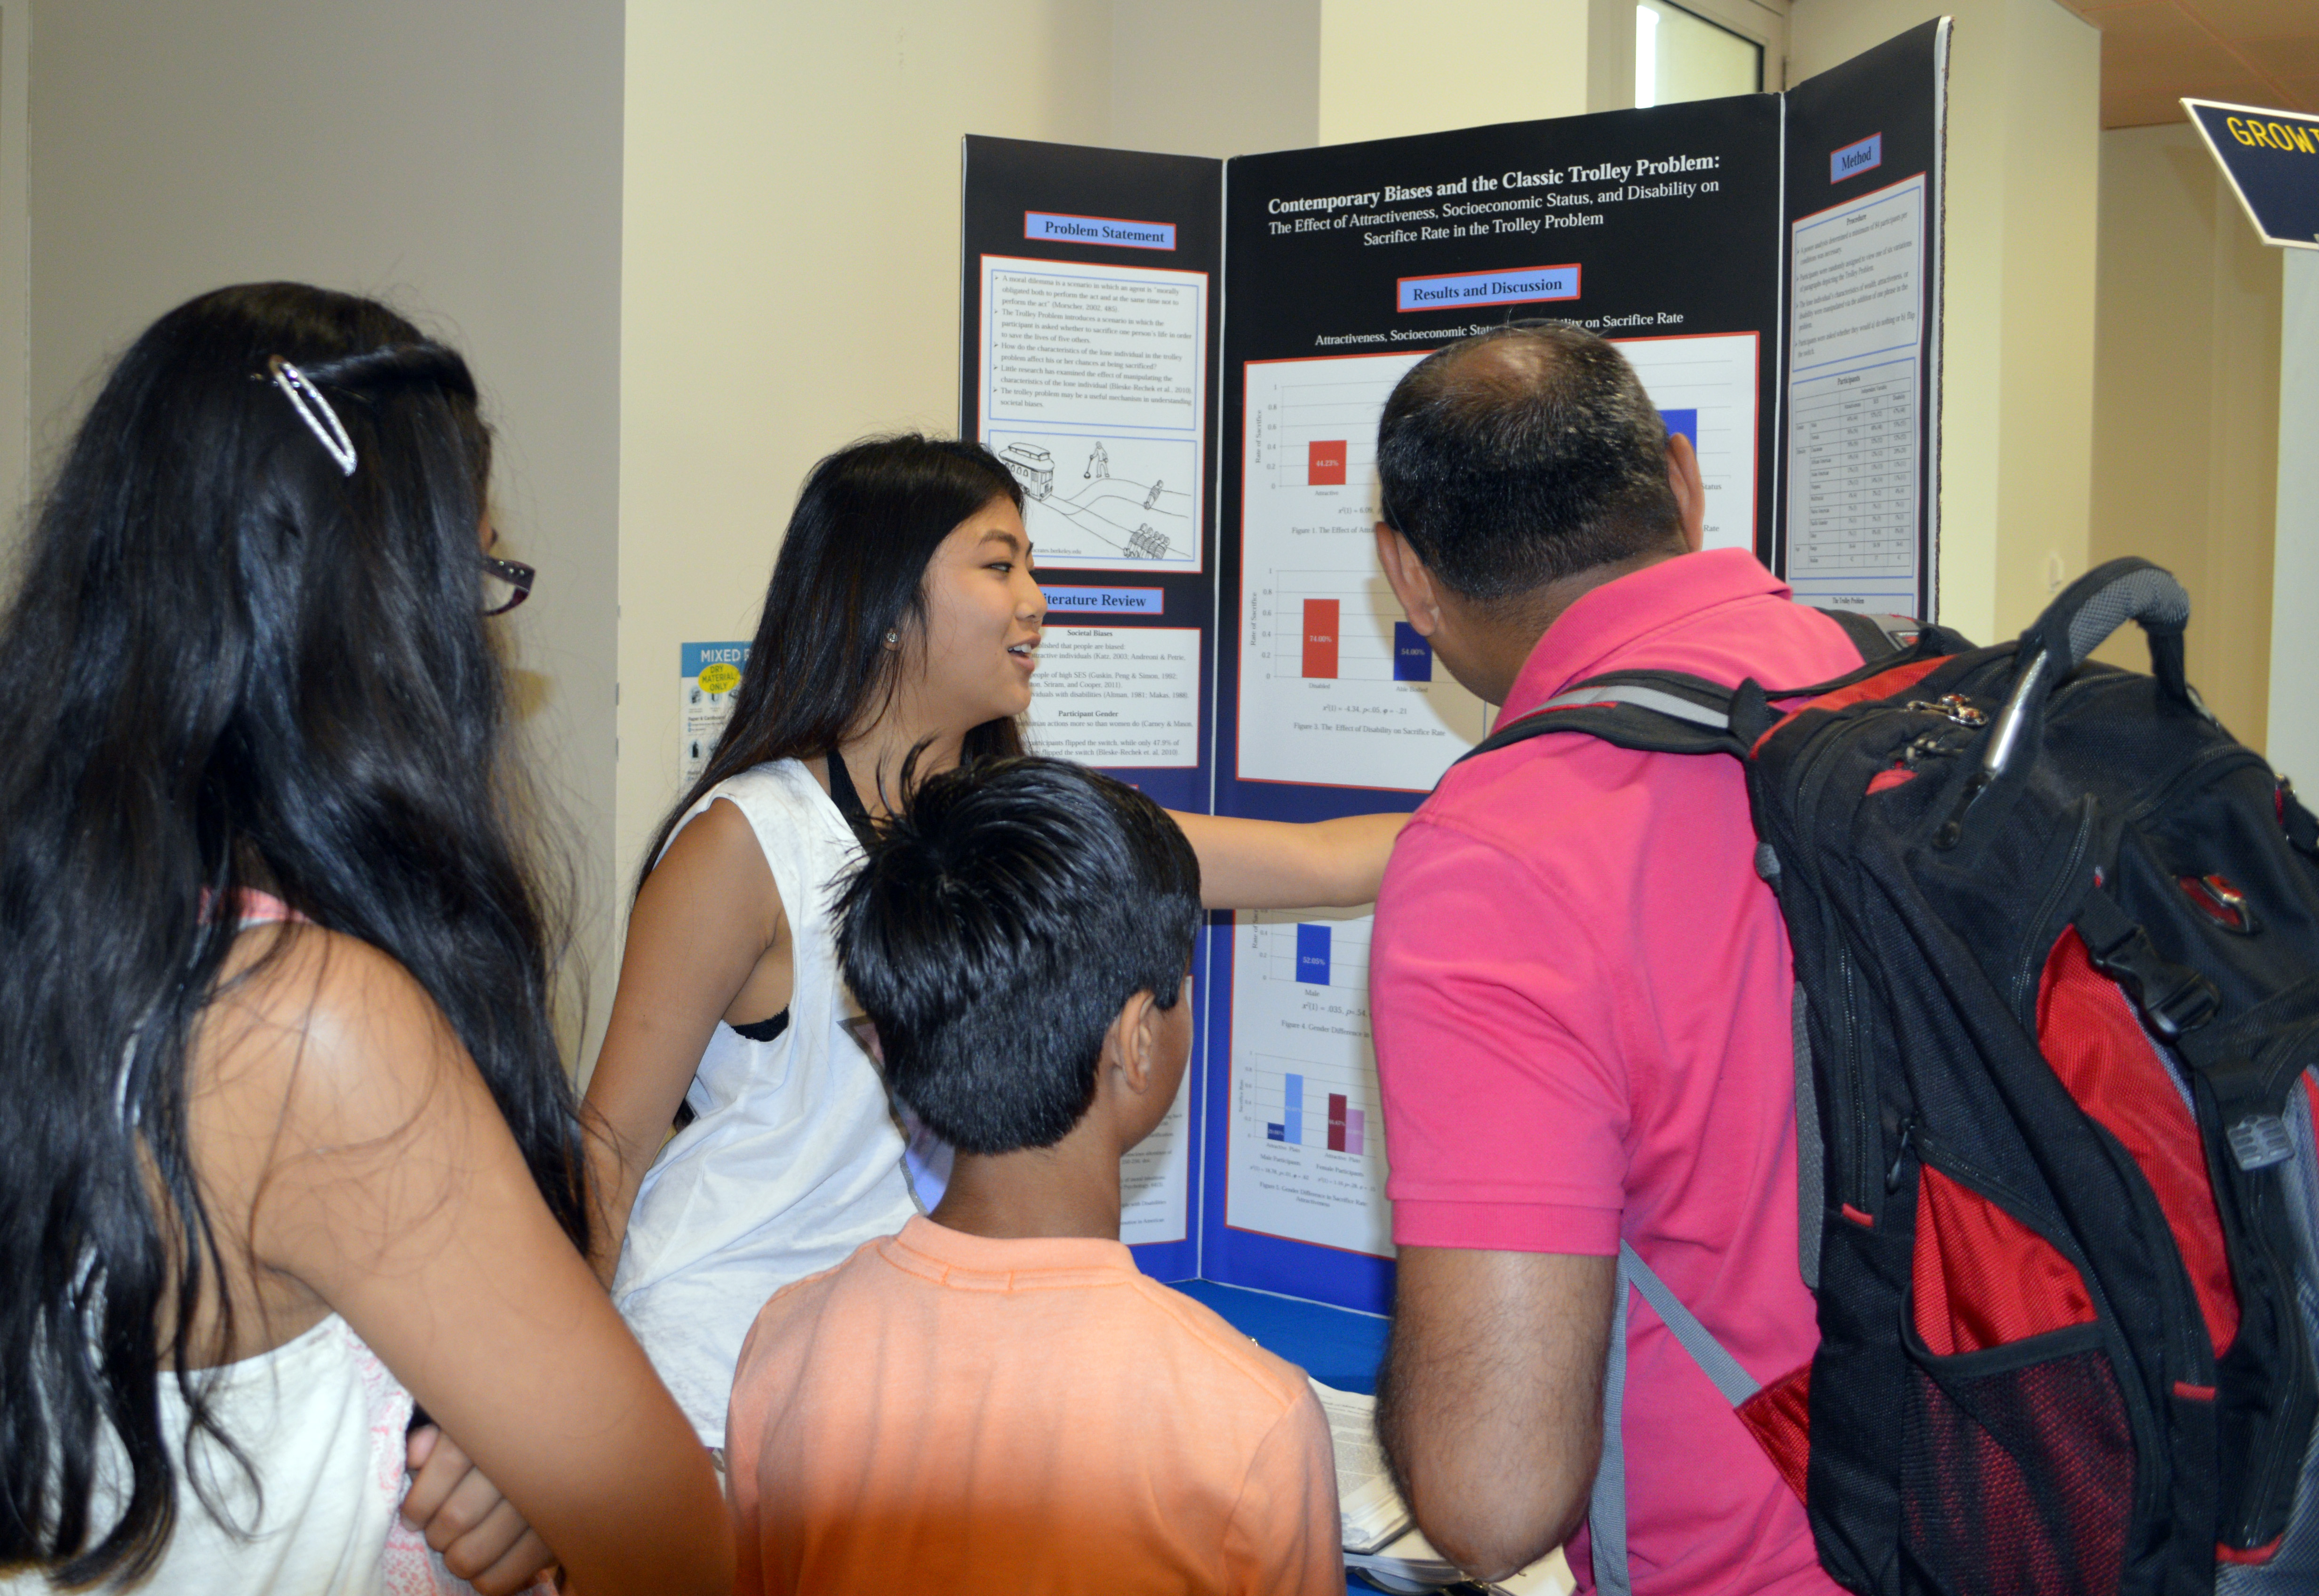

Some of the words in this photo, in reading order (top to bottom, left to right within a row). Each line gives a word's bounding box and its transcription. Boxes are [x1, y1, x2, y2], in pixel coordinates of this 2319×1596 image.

[1842, 146, 1871, 170] Method
[1268, 192, 1380, 214] Contemporary
[1384, 186, 1433, 202] Biases
[1436, 178, 1467, 196] and
[1471, 176, 1498, 192] the
[1502, 169, 1564, 188] Classic
[1568, 164, 1631, 182] Trolley
[1636, 156, 1719, 176] Problem:
[1269, 222, 1292, 234] The
[1295, 218, 1330, 232] Effect
[1334, 215, 1348, 228] of
[1349, 209, 1439, 226] Attractiveness,
[1442, 196, 1543, 217] Socioeconomic
[1546, 194, 1593, 207] Status,
[1598, 188, 1623, 203] and
[1627, 183, 1697, 200] Disability
[1701, 181, 1719, 192] on
[1847, 214, 1866, 225] Procedure
[1045, 221, 1098, 237] Problem
[1102, 226, 1164, 242] Statement
[1364, 230, 1417, 246] Sacrifice
[1421, 227, 1450, 240] Rate
[1453, 224, 1466, 237] in
[1469, 223, 1489, 235] the
[1492, 218, 1541, 233] Trolley
[1544, 214, 1604, 228] Problem
[1414, 287, 1459, 300] Results
[1463, 283, 1487, 296] and
[1492, 279, 1562, 294] Discussion
[1015, 310, 1036, 319] Trolley
[1585, 319, 1600, 328] on
[1603, 315, 1654, 327] Sacrifice
[1657, 313, 1684, 324] Rate
[1315, 334, 1387, 345] Attractiveness,
[1390, 327, 1467, 341] Socioeconomic
[1037, 345, 1080, 354] characteristics
[1107, 361, 1124, 369] being
[1045, 593, 1097, 605] iterature
[1102, 594, 1146, 606] Review
[701, 649, 740, 662] MIXED
[711, 665, 723, 673] DRY
[702, 672, 735, 683] MATERIAL
[710, 682, 727, 691] ONLY
[1294, 722, 1312, 731] Figure
[1363, 726, 1392, 735] Disability
[1303, 957, 1325, 965] 52.05%
[1281, 1020, 1300, 1029] Figure
[1308, 1024, 1330, 1032] Gender
[1331, 1027, 1362, 1038] Difference
